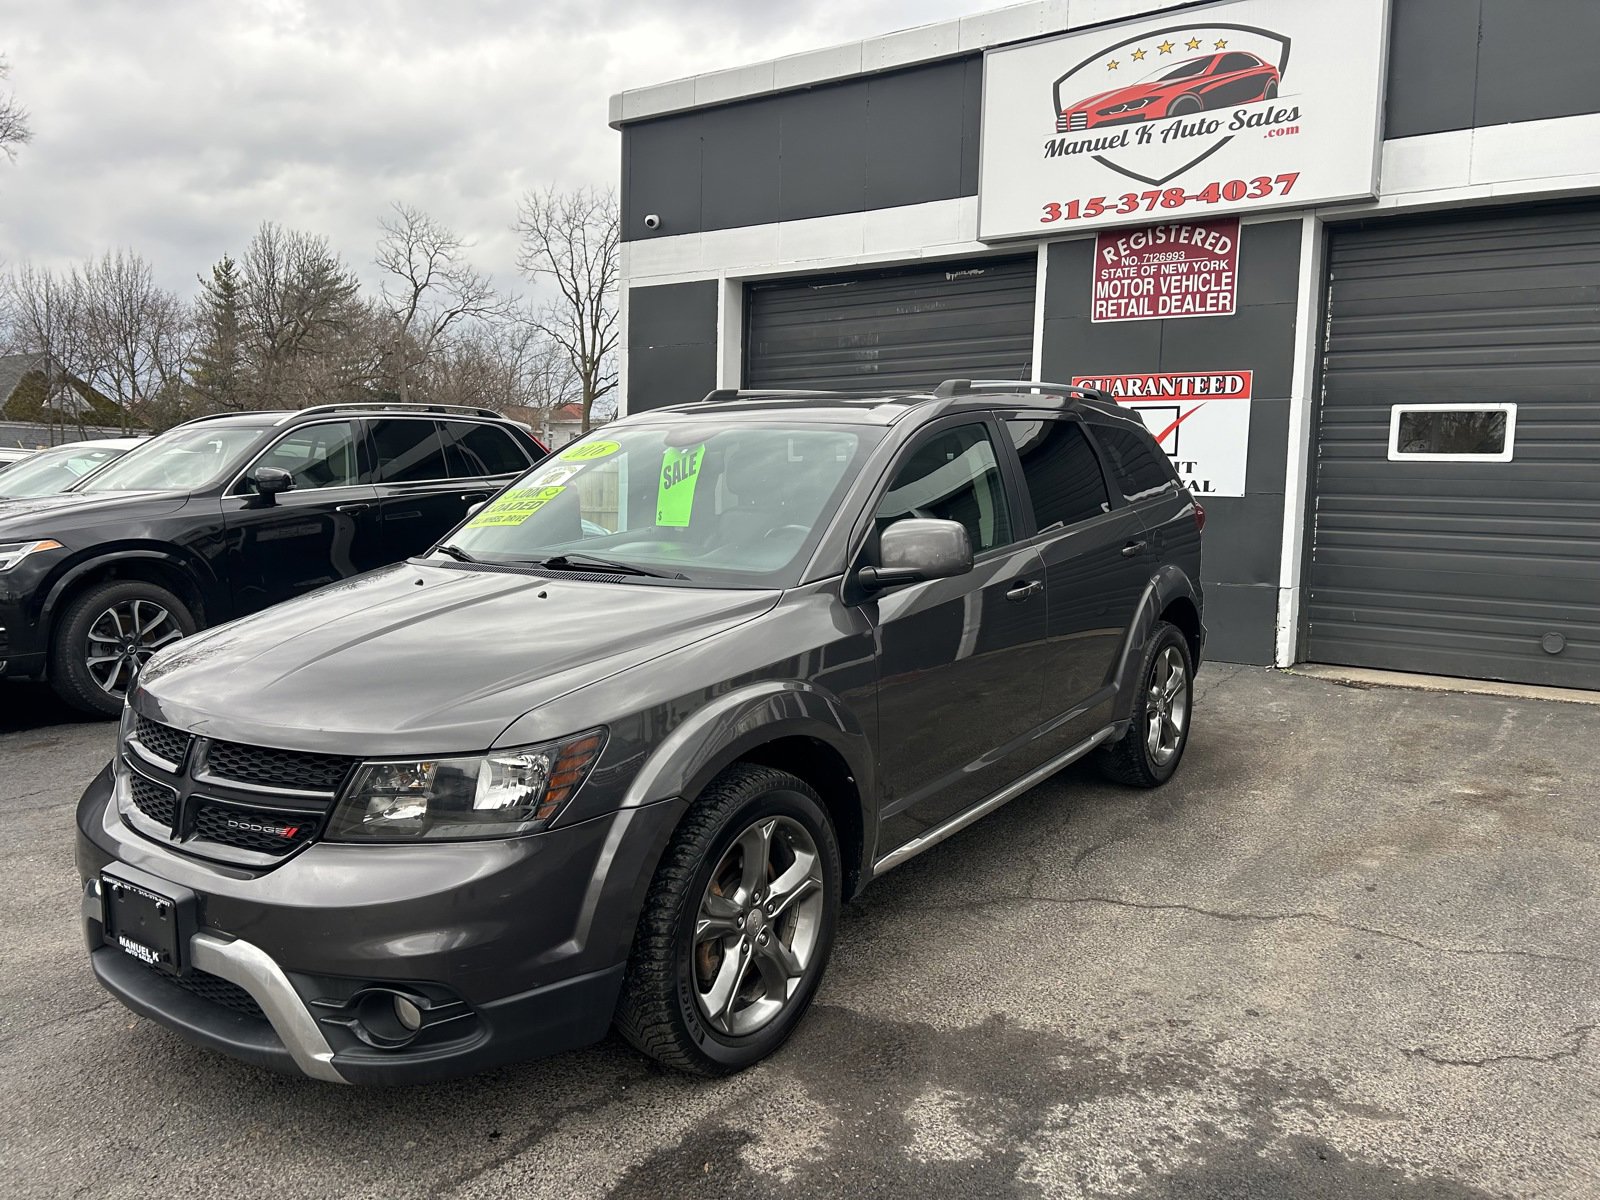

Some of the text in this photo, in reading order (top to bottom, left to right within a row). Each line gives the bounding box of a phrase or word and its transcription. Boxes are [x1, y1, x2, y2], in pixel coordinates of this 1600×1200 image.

[1044, 106, 1302, 159] Manuel K Auto Sales
[1263, 125, 1299, 139] .com
[1040, 172, 1301, 223] 315-378-4037
[1102, 225, 1232, 265] REGISTERED
[1101, 259, 1229, 280] STATE OF NEW YORK
[1121, 251, 1185, 267] NO. 7126993
[1096, 272, 1233, 299] MOTOR VEHICLE
[1095, 292, 1231, 318] RETAIL DEALER
[663, 452, 698, 490] SALE
[483, 500, 545, 514] LOADED
[657, 510, 663, 521] $
[227, 820, 288, 836] DODGE
[119, 936, 160, 962] MANUEL K
